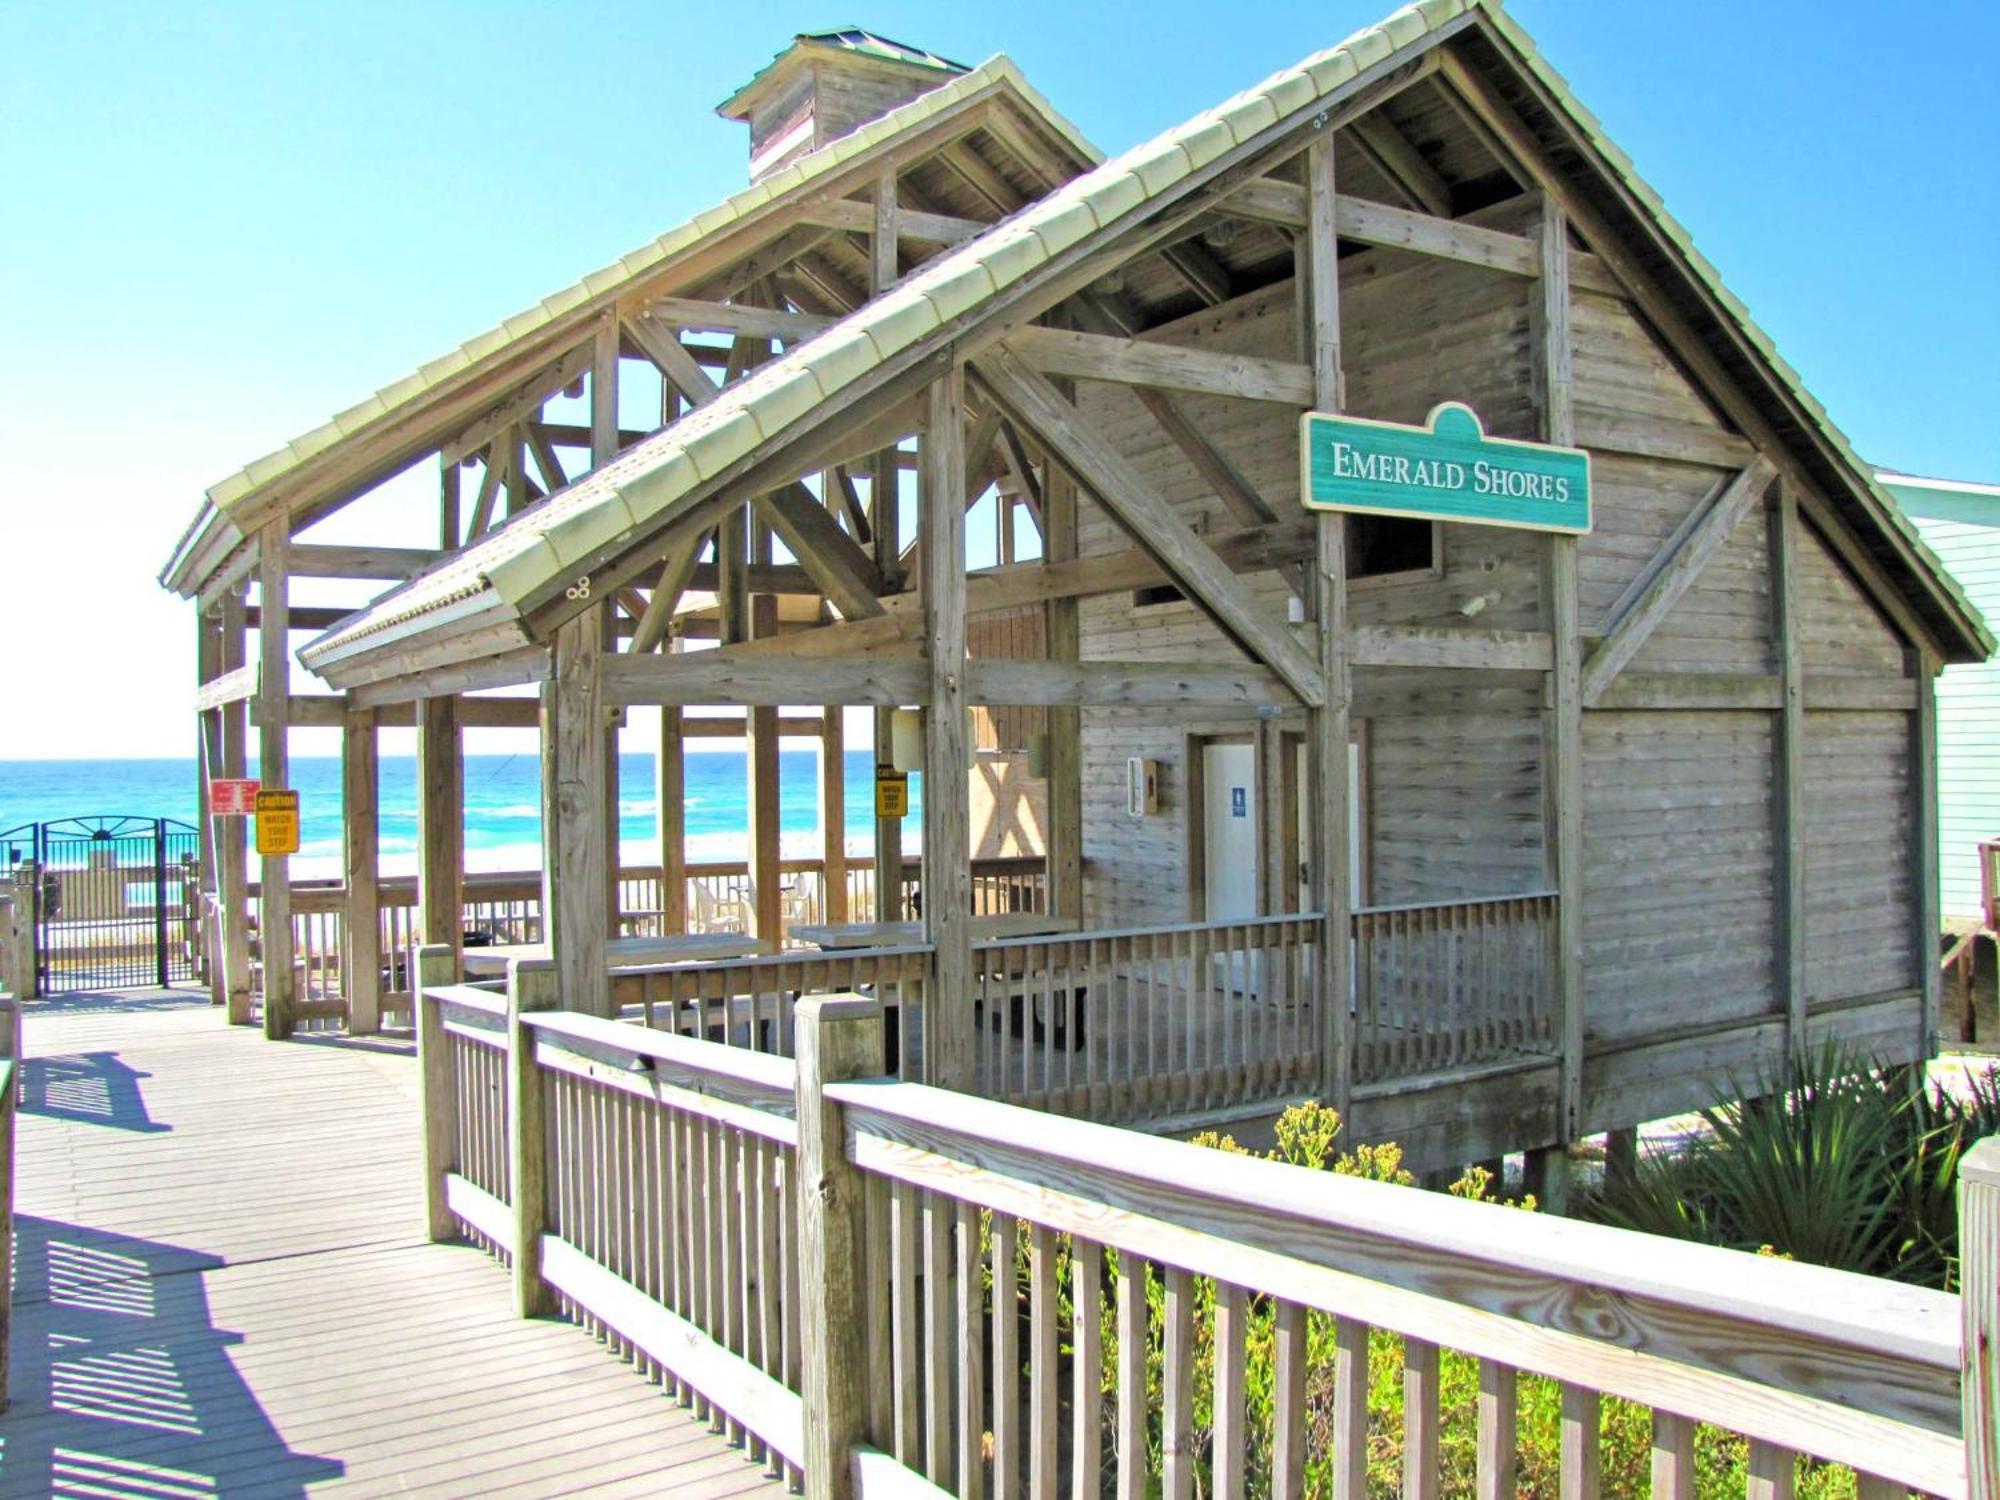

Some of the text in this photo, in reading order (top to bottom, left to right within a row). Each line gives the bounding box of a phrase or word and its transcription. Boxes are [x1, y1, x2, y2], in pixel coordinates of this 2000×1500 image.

[1331, 442, 1569, 503] EMERALD SHORES
[258, 796, 297, 807] CAUTION
